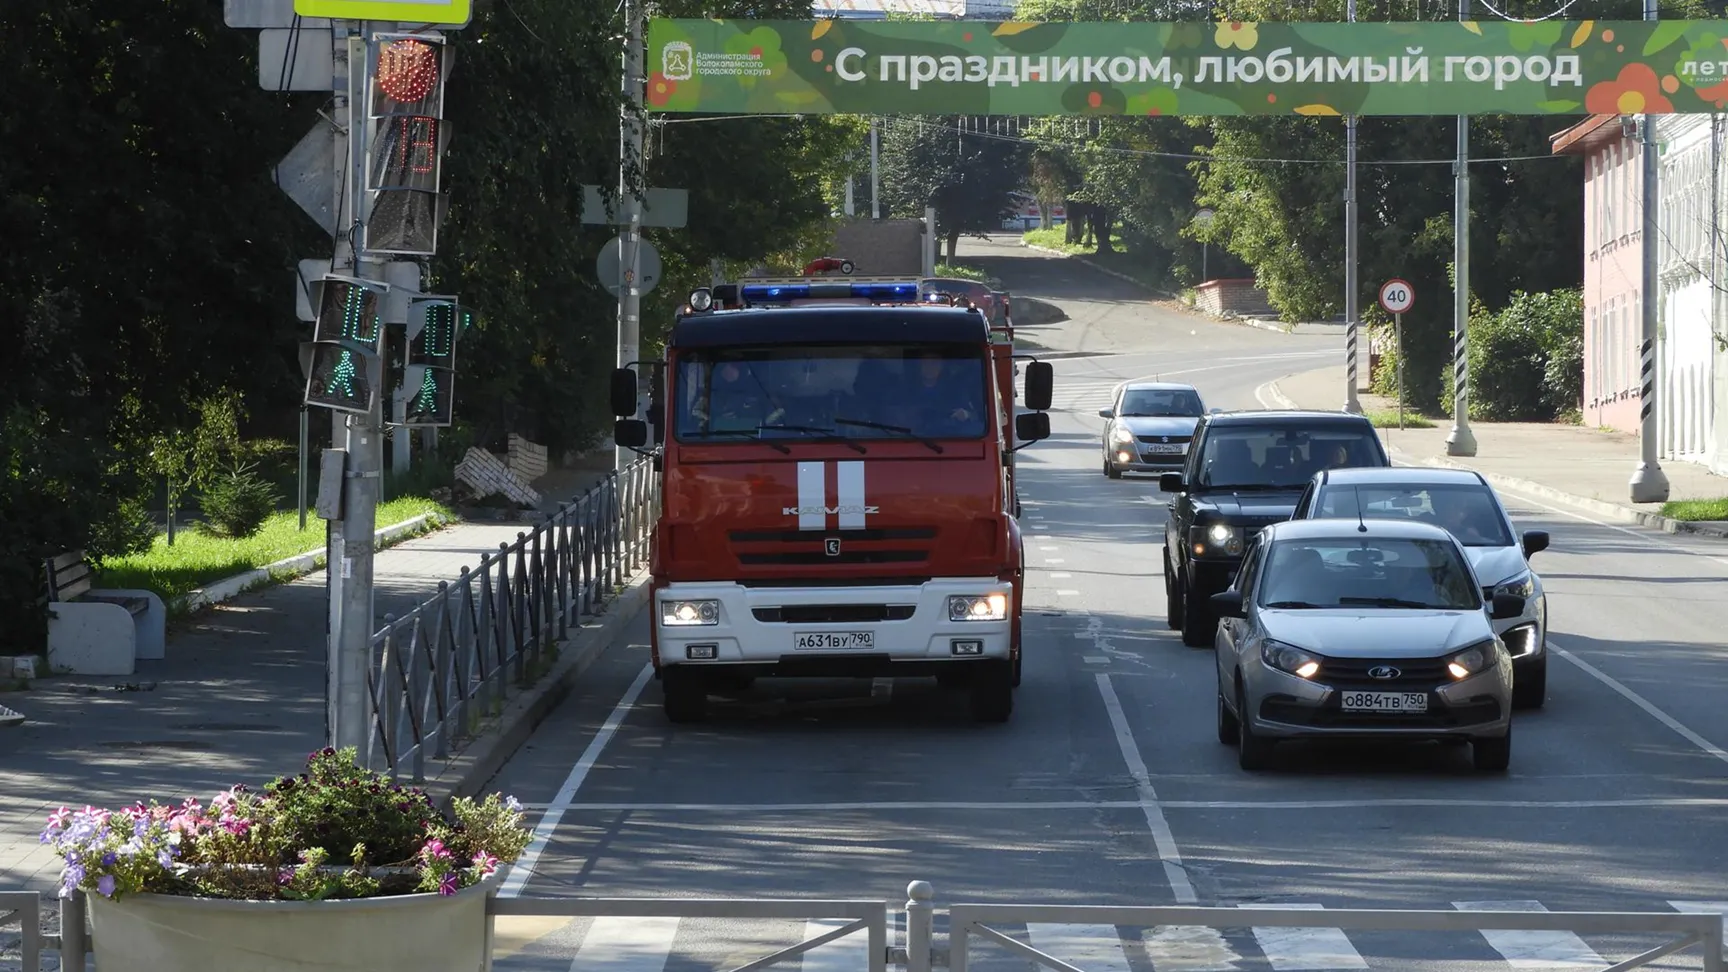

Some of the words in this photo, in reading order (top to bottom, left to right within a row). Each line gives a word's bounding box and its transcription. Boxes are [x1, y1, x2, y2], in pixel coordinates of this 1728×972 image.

[696, 51, 761, 62] Администрация
[696, 59, 764, 69] Волоколамского
[834, 48, 867, 82] С
[879, 55, 1184, 91] праздником,
[1195, 47, 1429, 83] любимый
[1444, 55, 1583, 91] город
[695, 67, 743, 76] городского
[743, 67, 772, 76] округа
[1387, 289, 1406, 303] 40
[782, 505, 880, 516] KAMAZ
[798, 634, 849, 648] А631ВУ
[851, 633, 871, 644] 790
[1345, 693, 1401, 709] О884ТВ
[1403, 693, 1424, 705] 750
